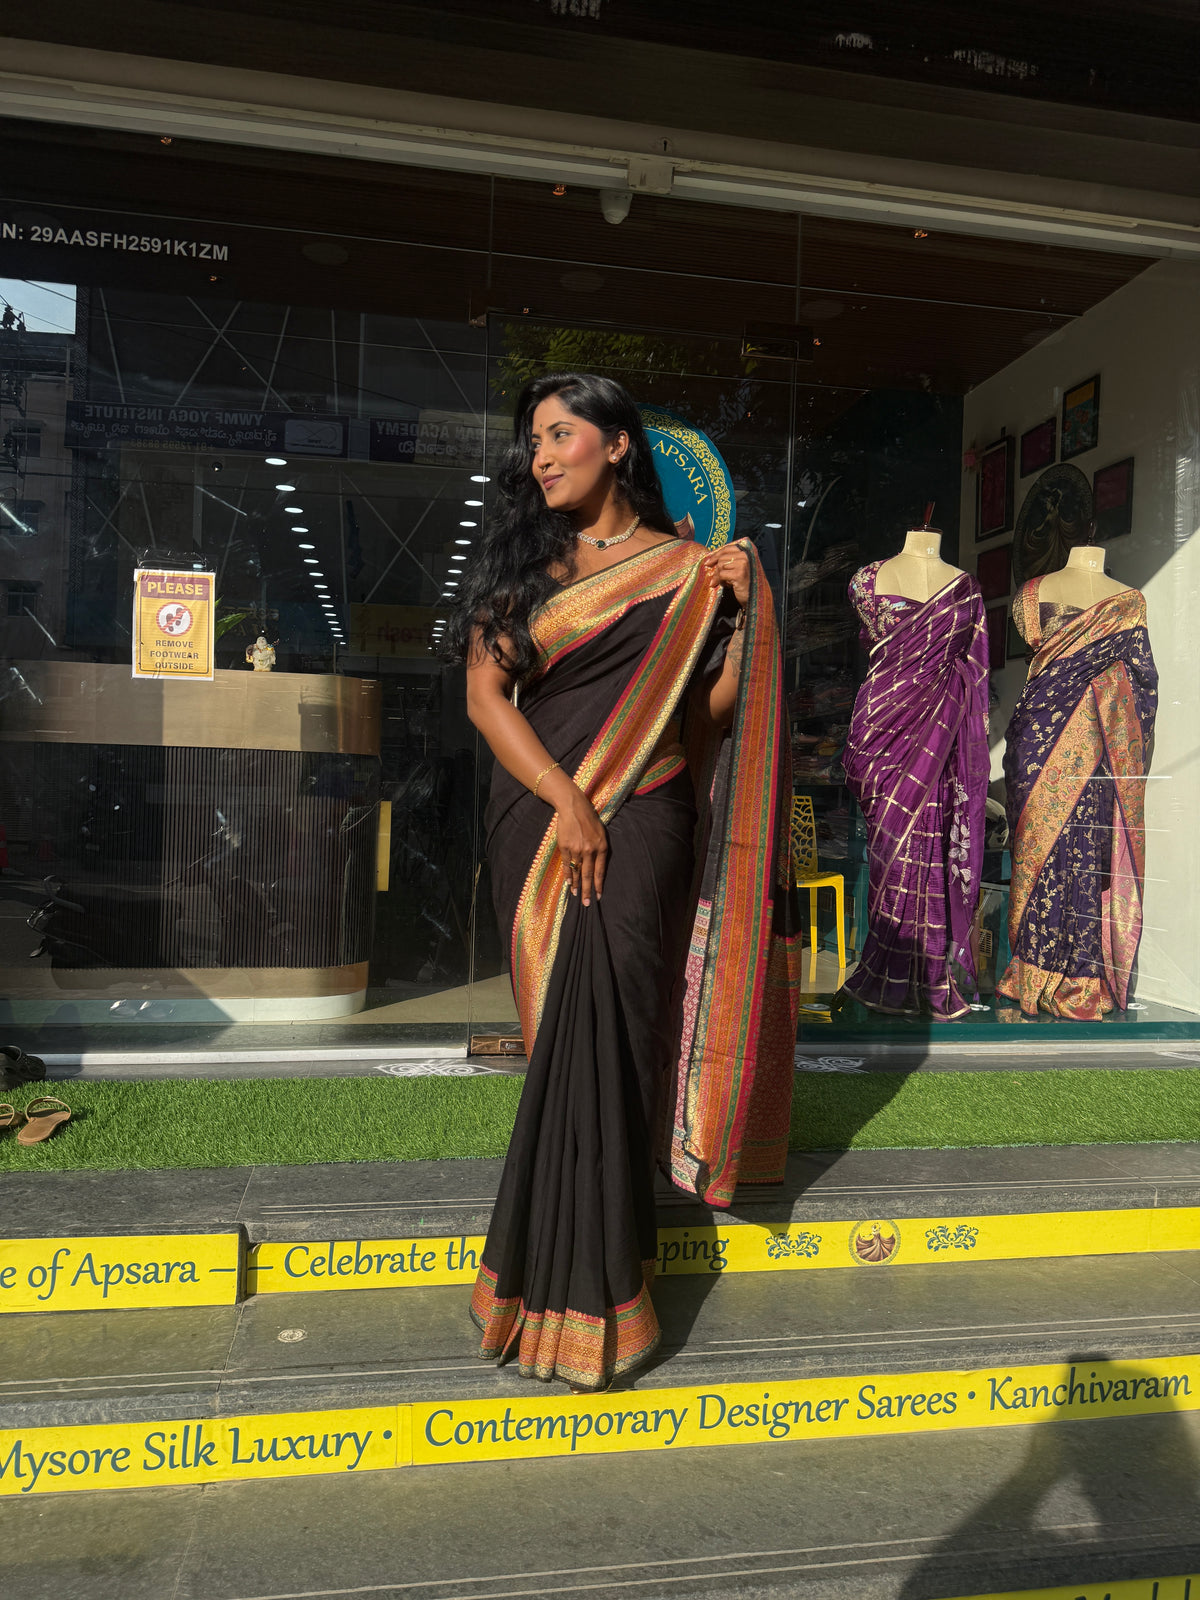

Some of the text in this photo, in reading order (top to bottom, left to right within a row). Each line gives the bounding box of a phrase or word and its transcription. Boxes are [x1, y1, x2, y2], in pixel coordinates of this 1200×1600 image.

[0, 222, 229, 262] N: 29AASFH2591K1ZM
[652, 439, 708, 505] APSARA
[147, 581, 204, 596] PLEASE
[149, 650, 199, 660] FOOTWEAR
[155, 639, 194, 649] REMOVE
[154, 661, 194, 670] OUTSIDE
[27, 1248, 71, 1301] of
[71, 1253, 200, 1299] Apsara
[284, 1241, 437, 1278] Celebrate
[445, 1236, 485, 1272] th
[656, 1231, 730, 1273] ping
[142, 1423, 218, 1471] Silk
[229, 1427, 373, 1471] Luxury
[424, 1407, 689, 1452] Contemporary
[696, 1393, 850, 1439] Designer
[856, 1384, 958, 1420] Sarees
[987, 1366, 1193, 1411] Kanchivaram
